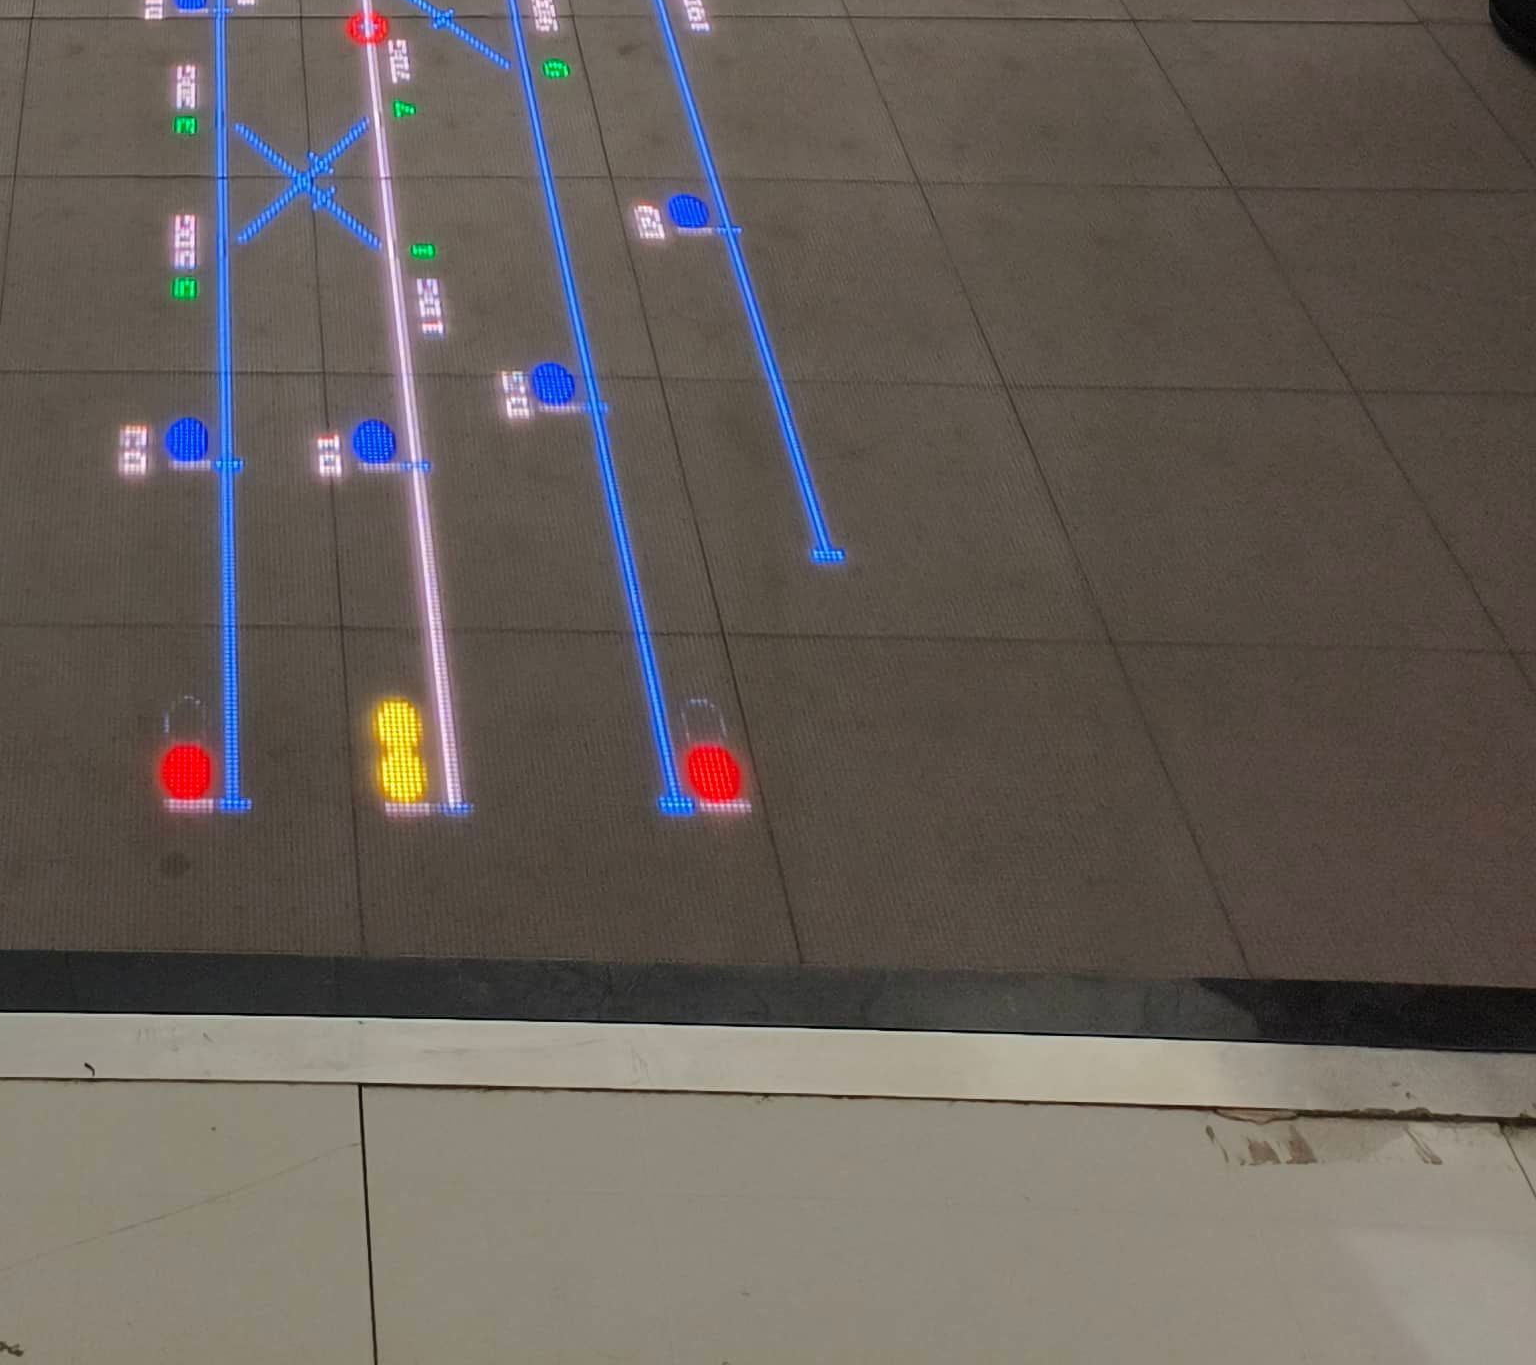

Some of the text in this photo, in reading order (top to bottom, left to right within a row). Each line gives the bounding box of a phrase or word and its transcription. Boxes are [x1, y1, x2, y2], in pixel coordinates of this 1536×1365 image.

[388, 40, 410, 83] 7DG
[392, 100, 416, 117] 7
[417, 279, 443, 333] 1DG
[318, 435, 342, 477] D1
